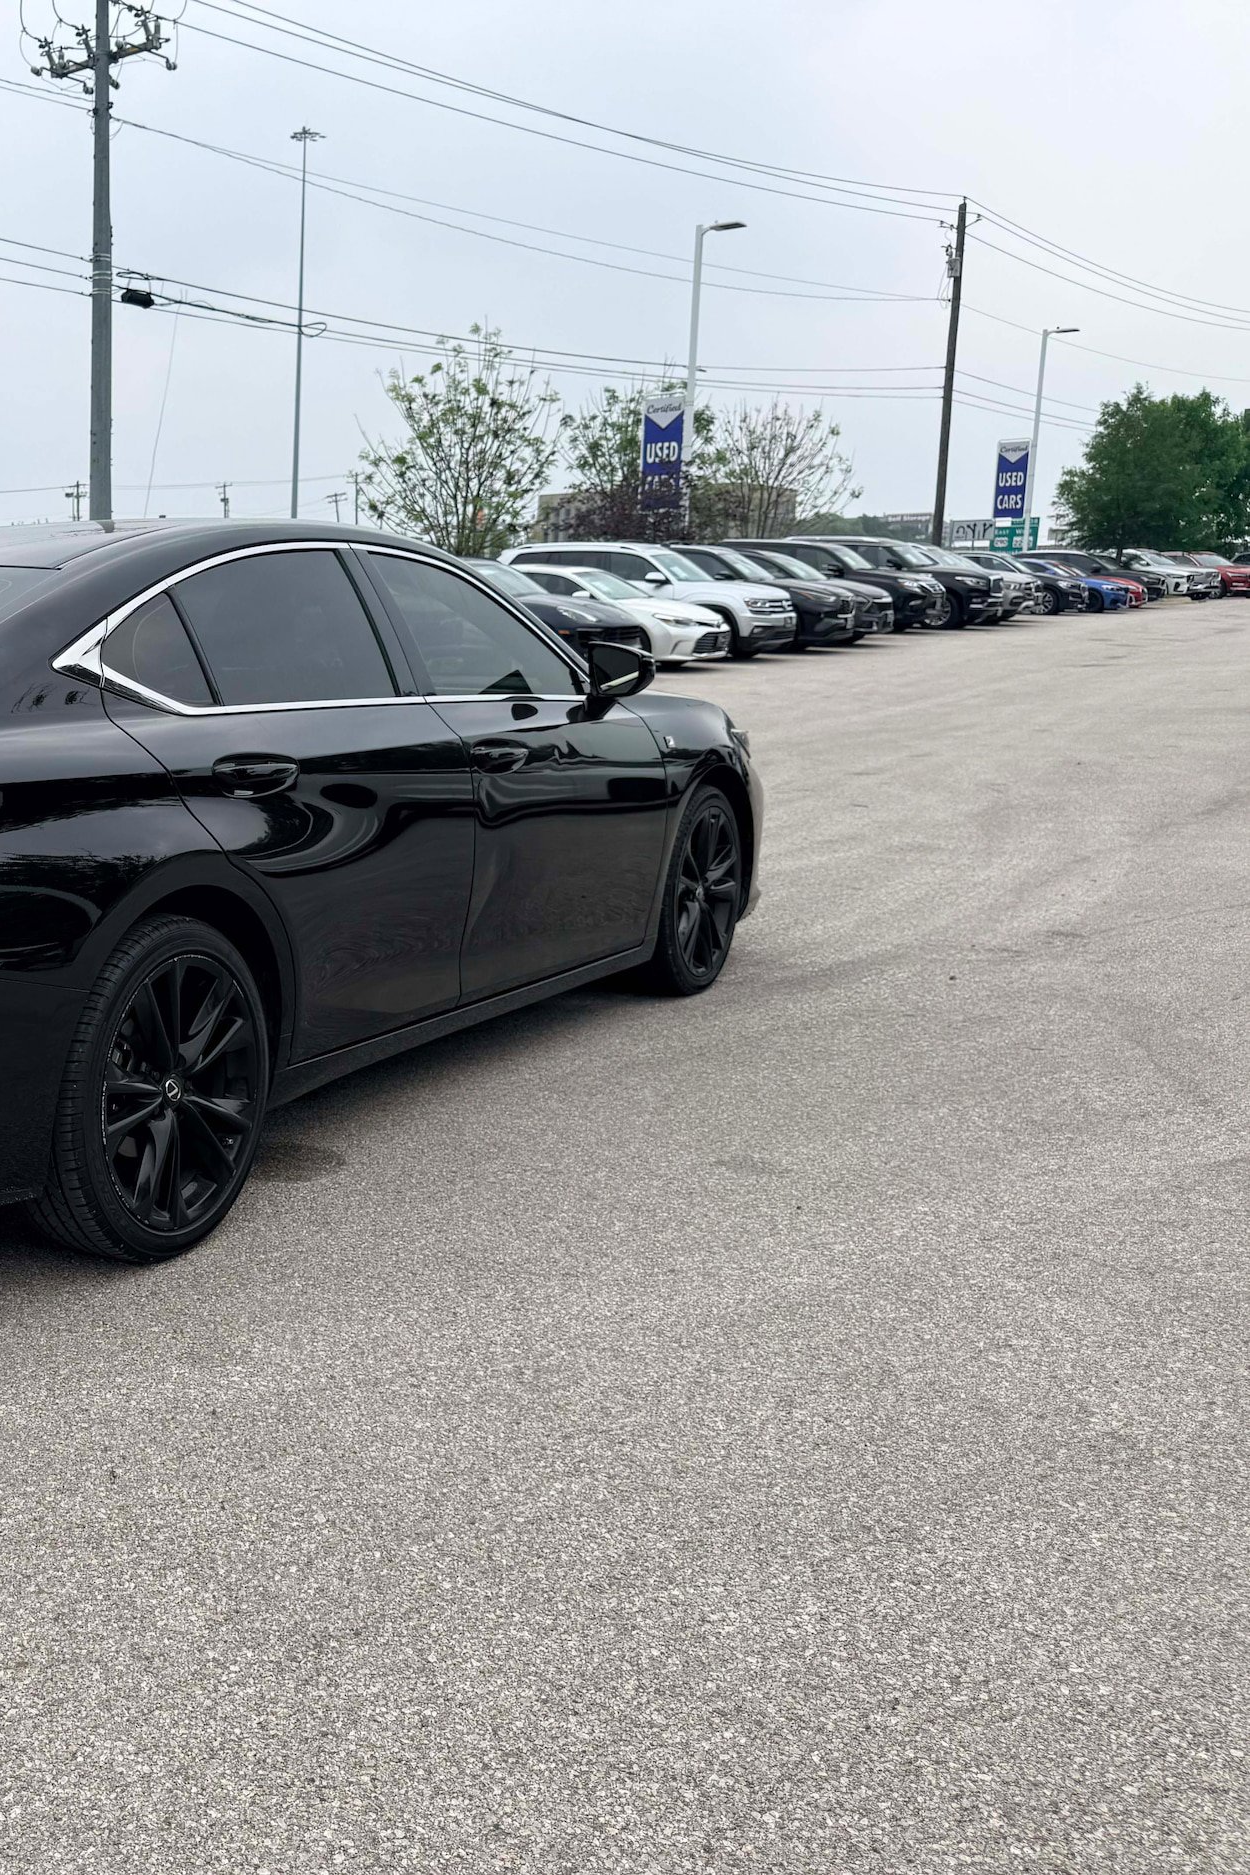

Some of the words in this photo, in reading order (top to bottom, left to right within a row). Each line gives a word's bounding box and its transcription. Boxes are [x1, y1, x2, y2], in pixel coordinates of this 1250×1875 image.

[647, 403, 682, 414] Certified
[646, 441, 678, 464] USED
[999, 472, 1024, 487] USED
[997, 495, 1022, 509] CARS
